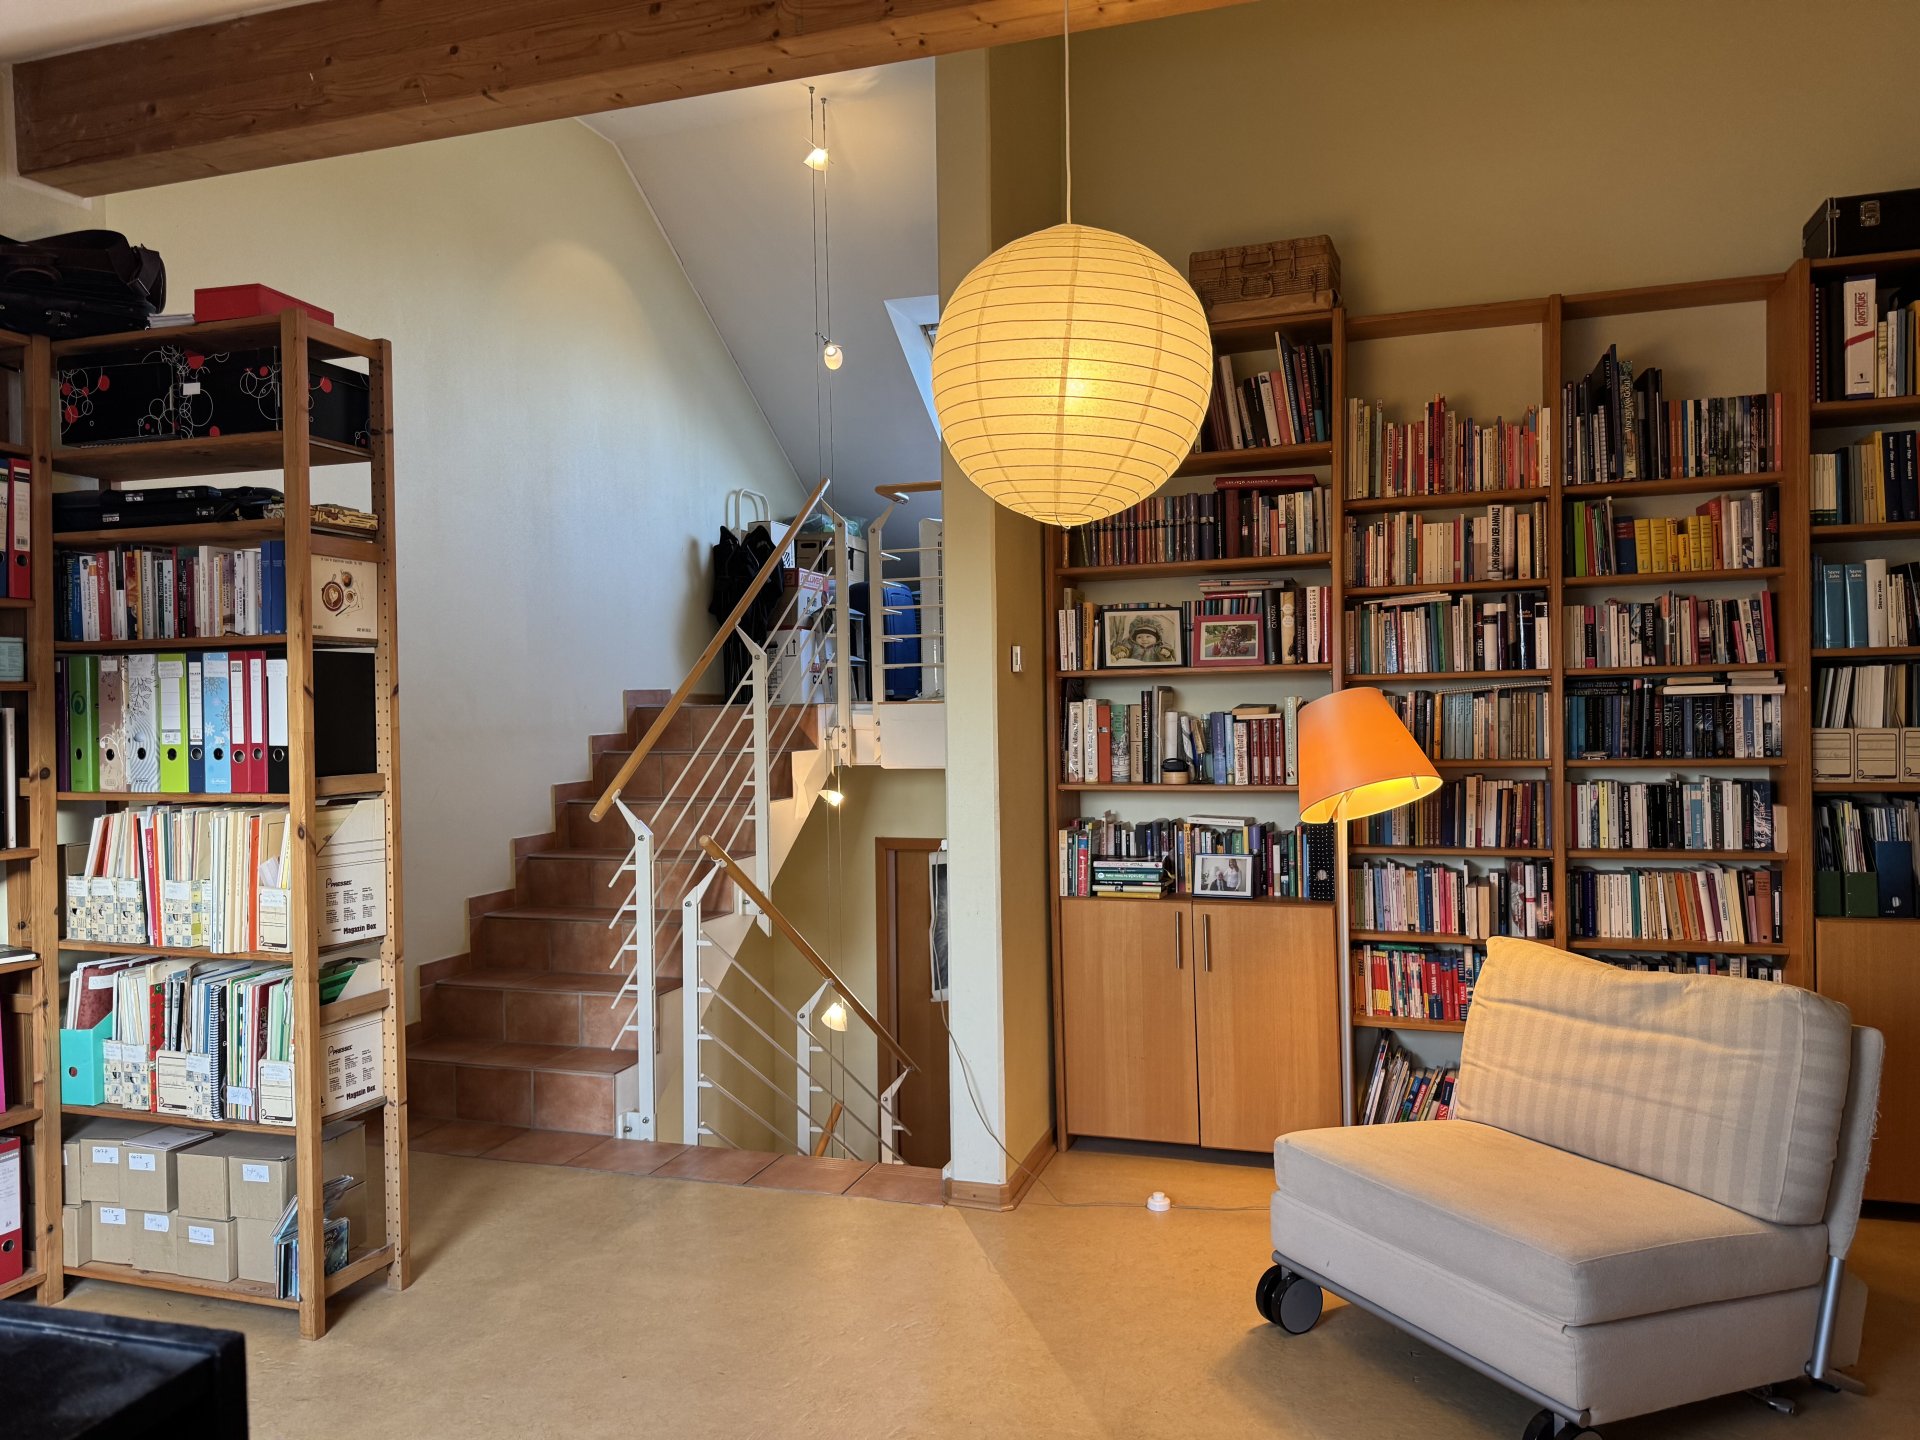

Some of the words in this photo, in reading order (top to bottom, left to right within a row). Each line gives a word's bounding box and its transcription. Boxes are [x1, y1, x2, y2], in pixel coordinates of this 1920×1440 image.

[1624, 379, 1632, 398] GOGH
[1624, 409, 1632, 433] VINCENT
[1491, 507, 1500, 526] ANWALT
[1492, 526, 1500, 536] DER
[1491, 537, 1500, 557] GRISHAM
[1492, 557, 1500, 570] JOHN
[1645, 608, 1654, 637] GRISHAM
[1654, 708, 1662, 727] LEON
[1664, 705, 1672, 727] LEON
[1673, 706, 1681, 727] LEON
[1695, 703, 1704, 727] LEON
[1705, 703, 1713, 727] LEON
[1726, 702, 1734, 727] LEON
[1735, 717, 1743, 734] Leon
[343, 925, 366, 935] Magazin
[366, 923, 377, 931] Box
[346, 1089, 367, 1101] Magazin
[366, 1085, 376, 1094] Box
